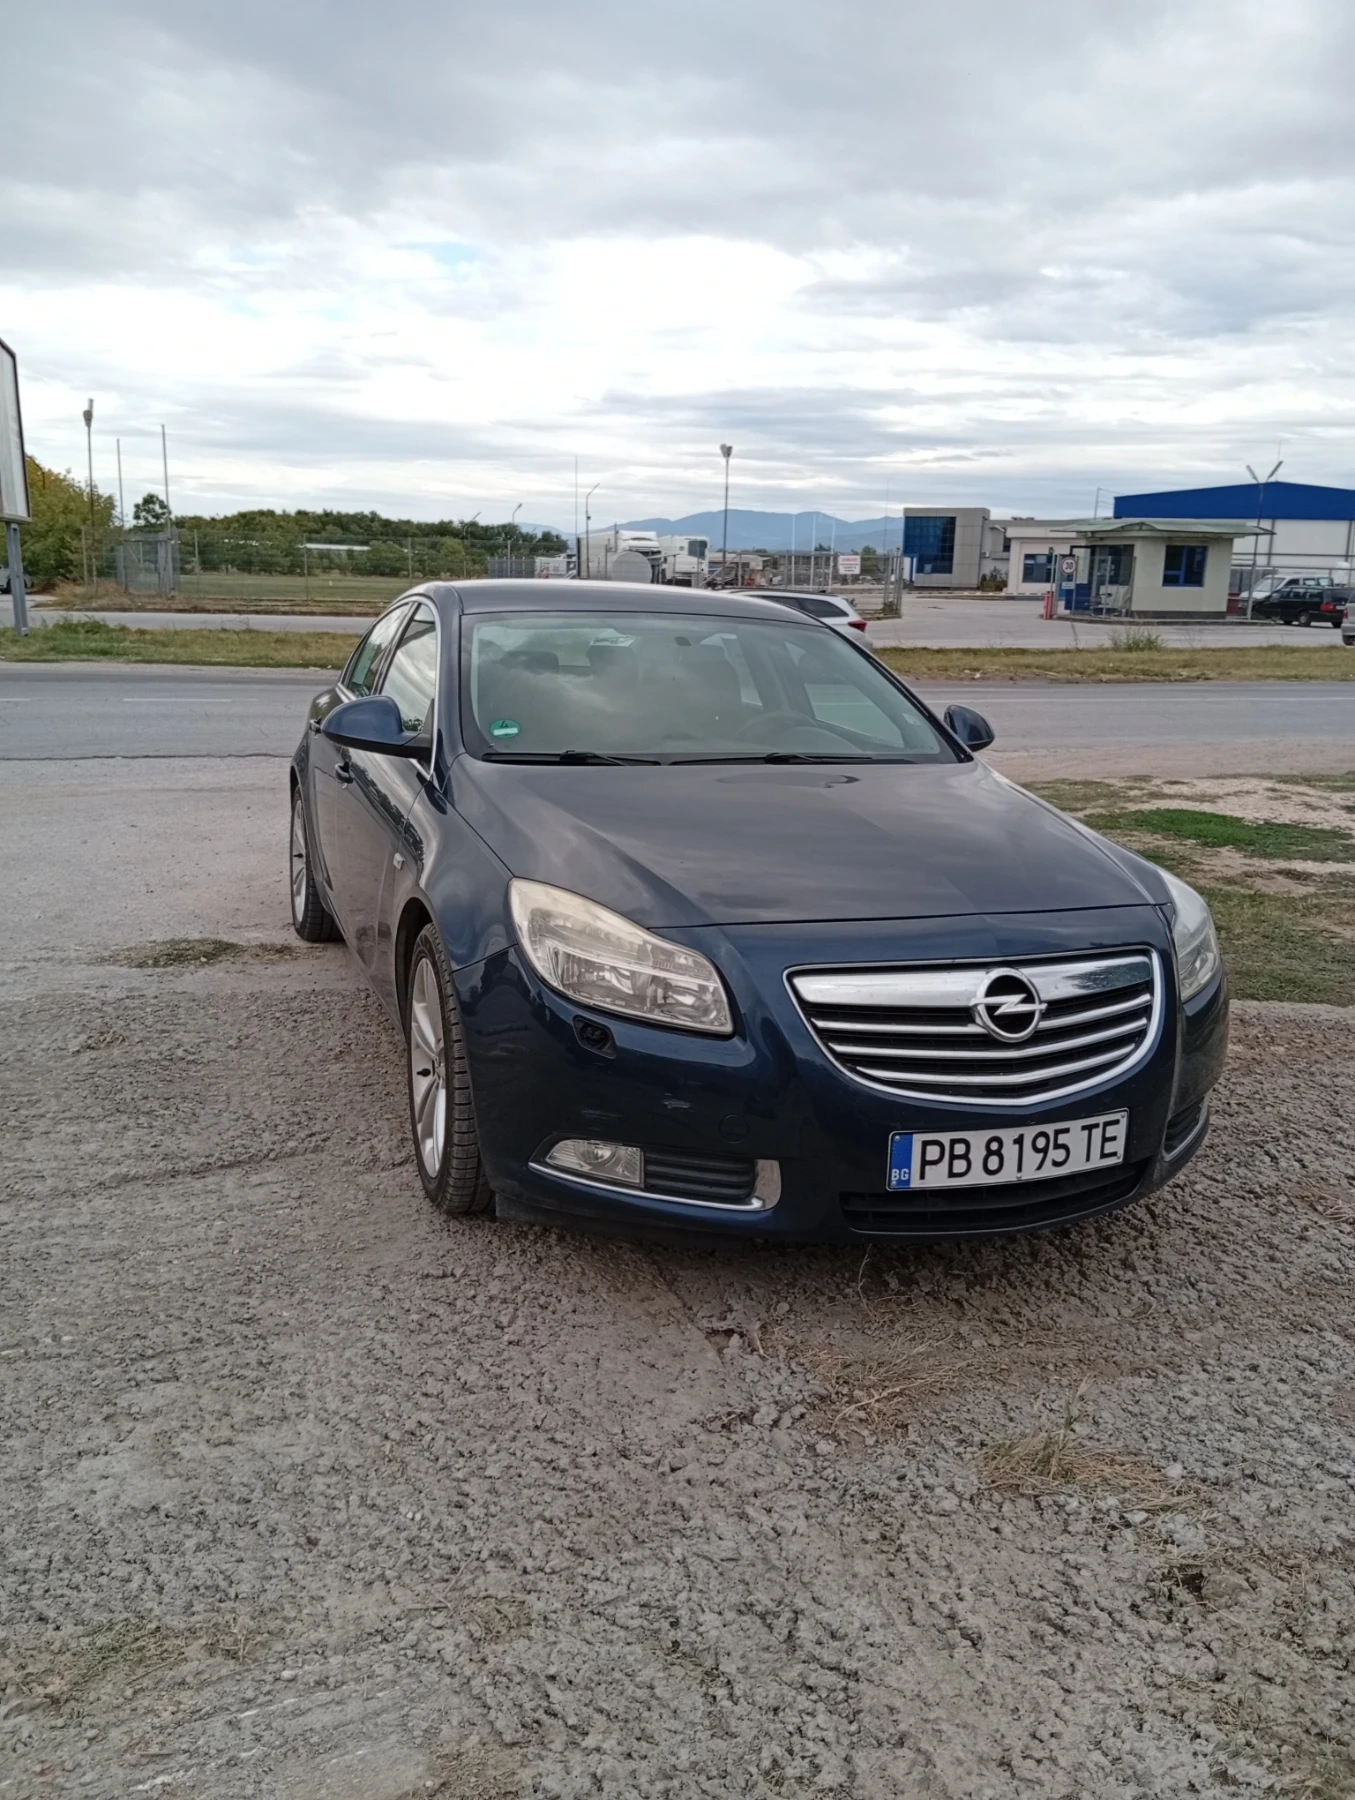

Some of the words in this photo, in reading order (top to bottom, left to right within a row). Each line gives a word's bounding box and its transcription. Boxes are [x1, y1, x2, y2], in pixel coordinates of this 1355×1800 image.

[919, 1137, 972, 1180] PB
[982, 1127, 1071, 1176] 8195
[1081, 1119, 1121, 1163] TE
[890, 1168, 909, 1181] BG
